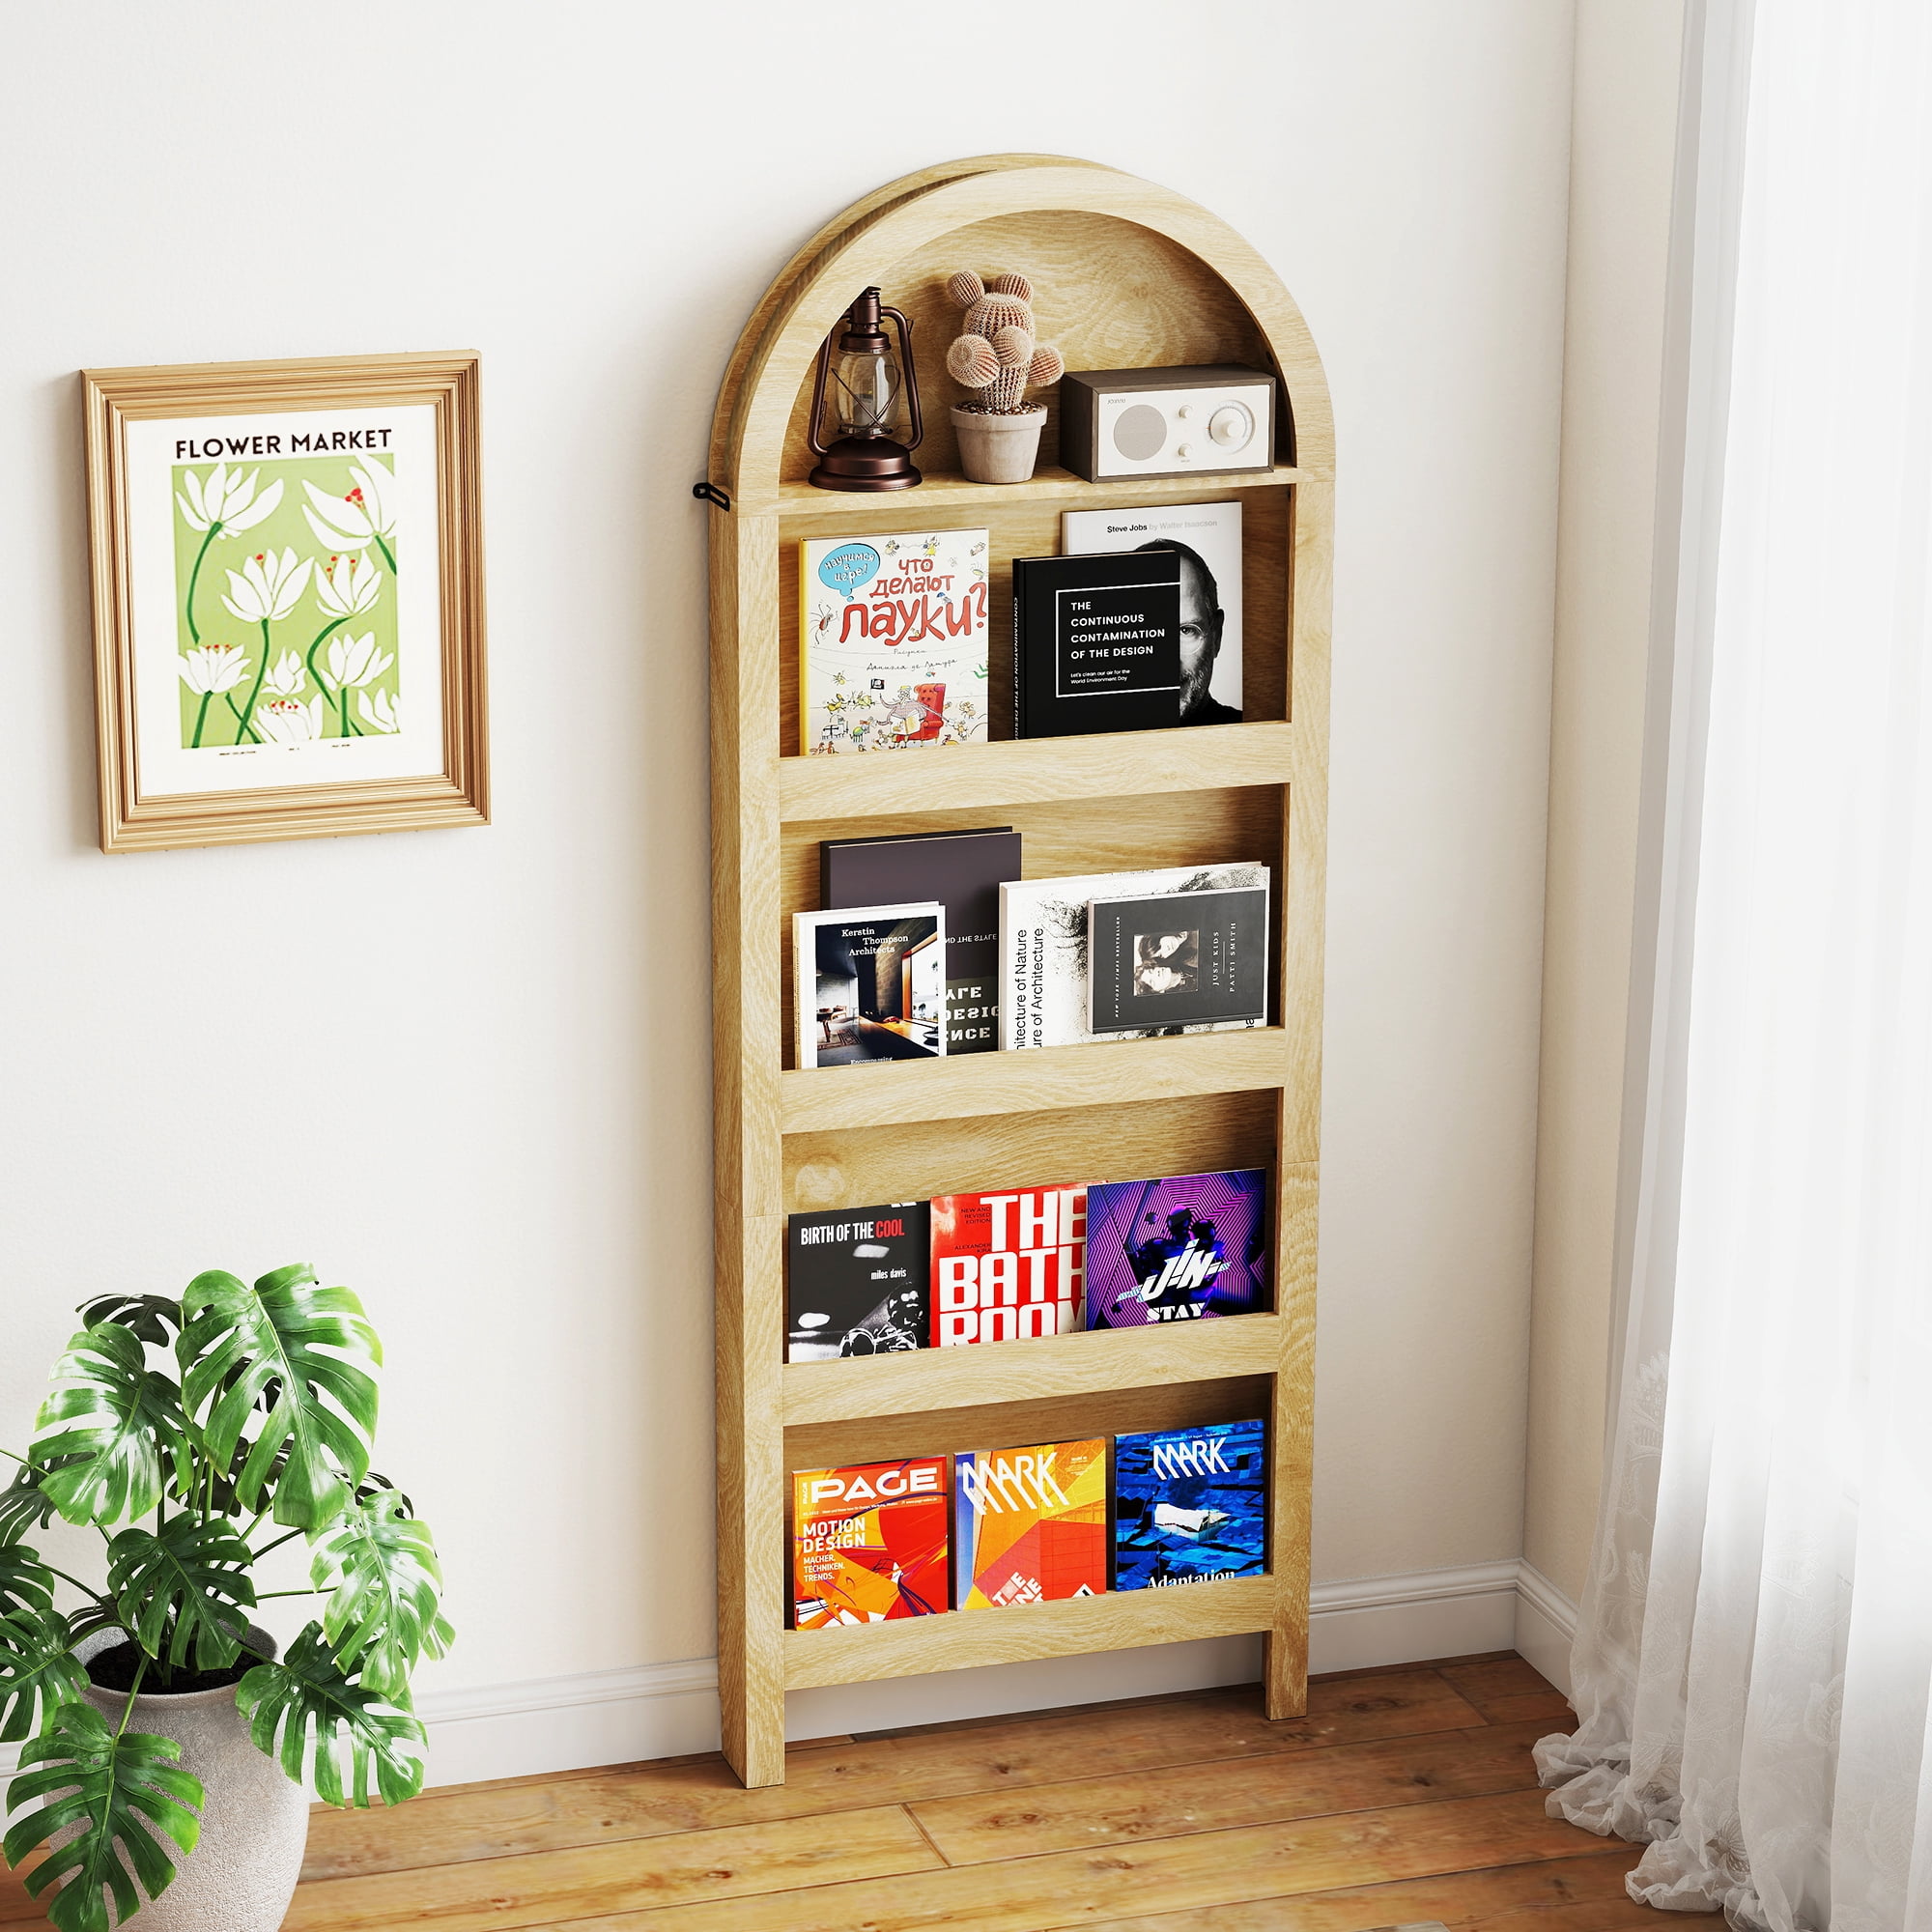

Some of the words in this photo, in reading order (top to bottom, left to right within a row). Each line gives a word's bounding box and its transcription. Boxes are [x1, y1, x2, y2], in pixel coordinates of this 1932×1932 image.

[176, 436, 281, 459] FLOWER
[292, 429, 392, 452] MARKET
[869, 575, 954, 598] делают
[838, 582, 987, 646] пауки?
[1070, 602, 1092, 611] THE
[1070, 614, 1145, 627] CONTINUOUS
[1070, 629, 1165, 643] CONTAMINATION
[1070, 650, 1086, 660] OF
[1089, 648, 1109, 658] THE
[1113, 645, 1153, 657] DESIGN
[841, 927, 874, 937] Kerstin
[863, 935, 909, 946] Thompson
[848, 946, 895, 956] Architects
[1015, 929, 1027, 975] Nature
[1031, 928, 1044, 1009] Architecture
[1015, 979, 1027, 991] of
[1031, 1013, 1042, 1026] of
[980, 1188, 1087, 1252] THE
[801, 1225, 835, 1245] BIRTH
[837, 1224, 850, 1241] OF
[853, 1221, 874, 1239] THE
[875, 1219, 905, 1237] COOL
[870, 1269, 888, 1280] miles
[890, 1267, 907, 1279] davis
[939, 1243, 1086, 1312] BATH
[1147, 1302, 1206, 1321] STAY
[1153, 1437, 1231, 1480] MARK
[810, 1467, 938, 1504] PAGE
[962, 1452, 1069, 1516] MARK
[803, 1517, 866, 1538] MOTION
[803, 1532, 866, 1553] DESIGN
[804, 1554, 836, 1565] MACHER.
[804, 1562, 846, 1574] TECHNIKEN.
[804, 1573, 836, 1582] TRENDS.
[1147, 1569, 1236, 1589] Adaptation
